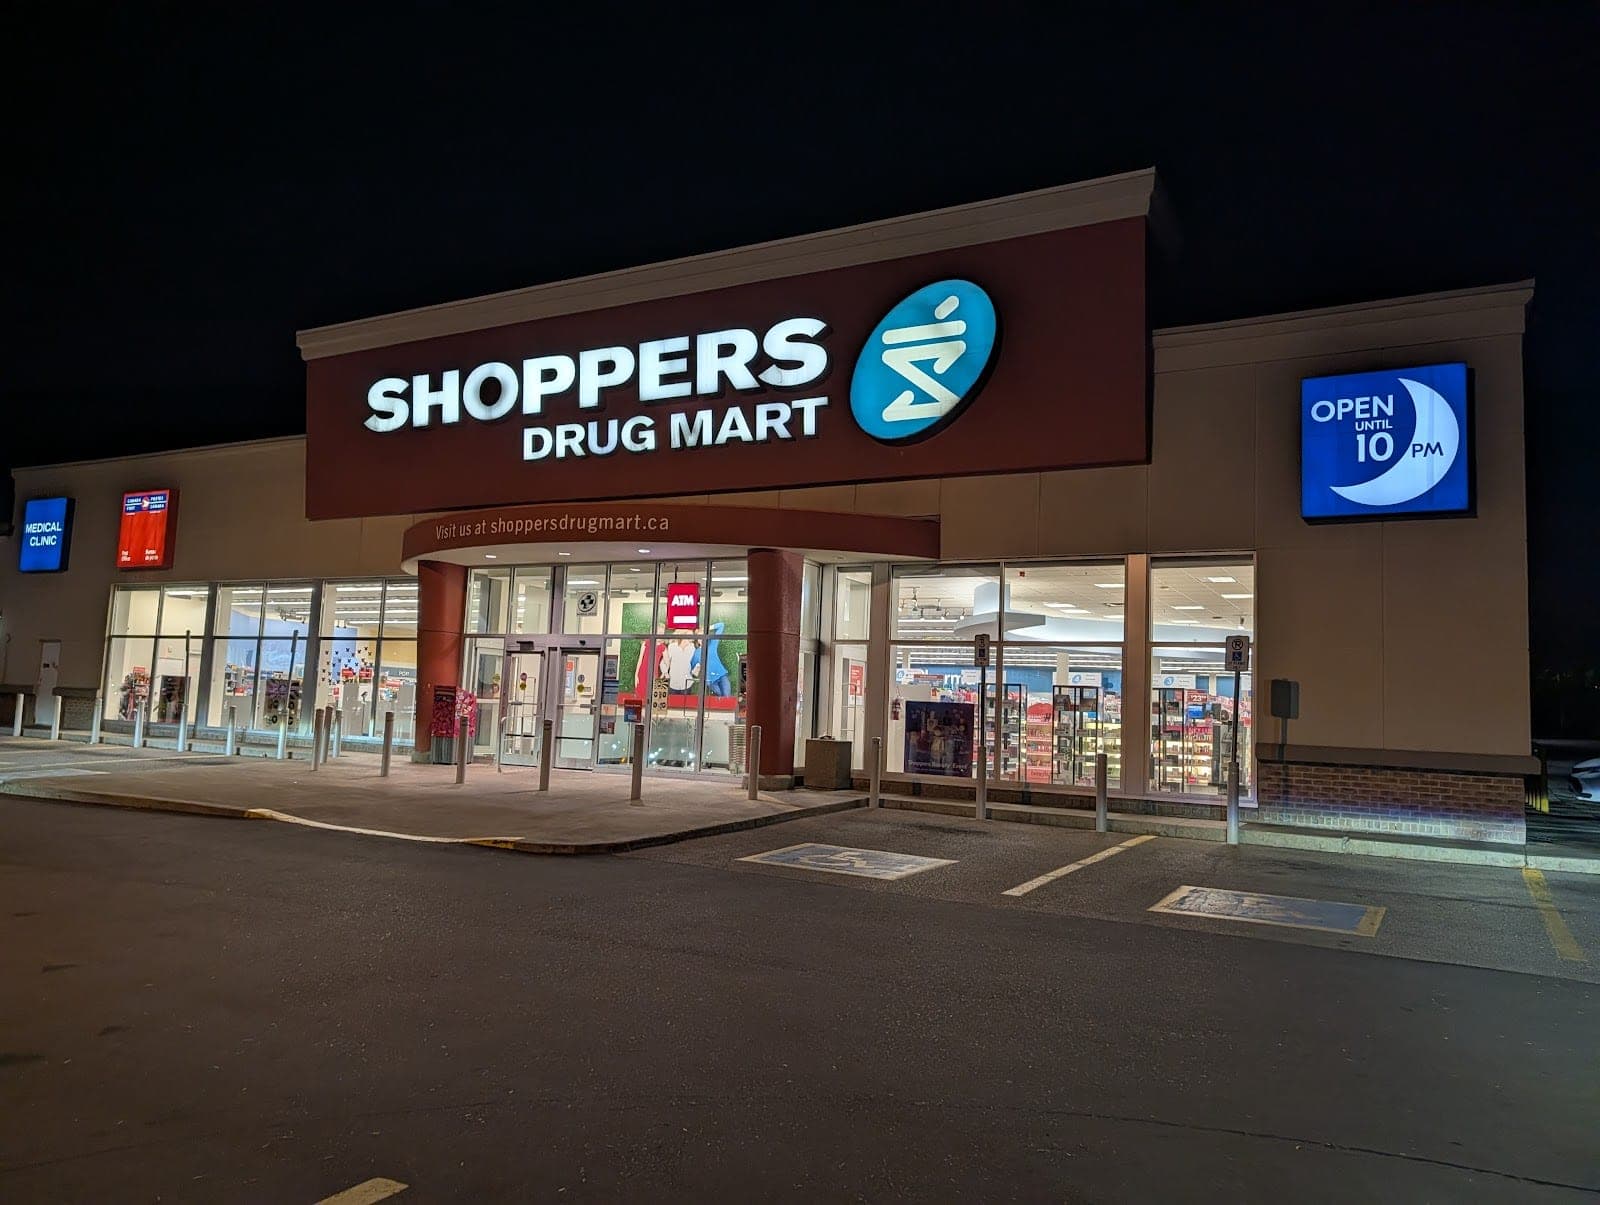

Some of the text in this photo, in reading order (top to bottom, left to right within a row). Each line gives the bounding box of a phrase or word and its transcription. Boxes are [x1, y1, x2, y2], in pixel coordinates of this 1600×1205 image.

[363, 317, 828, 433] SHOPPERS
[1310, 394, 1394, 422] OPEN
[522, 396, 829, 461] DRUG MART
[1354, 419, 1393, 431] UNTIL
[1356, 431, 1444, 463] 10 PM
[25, 521, 62, 534] MEDICAL
[435, 514, 670, 540] Visit us at shoppersdrugmart.ca
[29, 534, 57, 547] CLINIC
[671, 594, 695, 607] ATM
